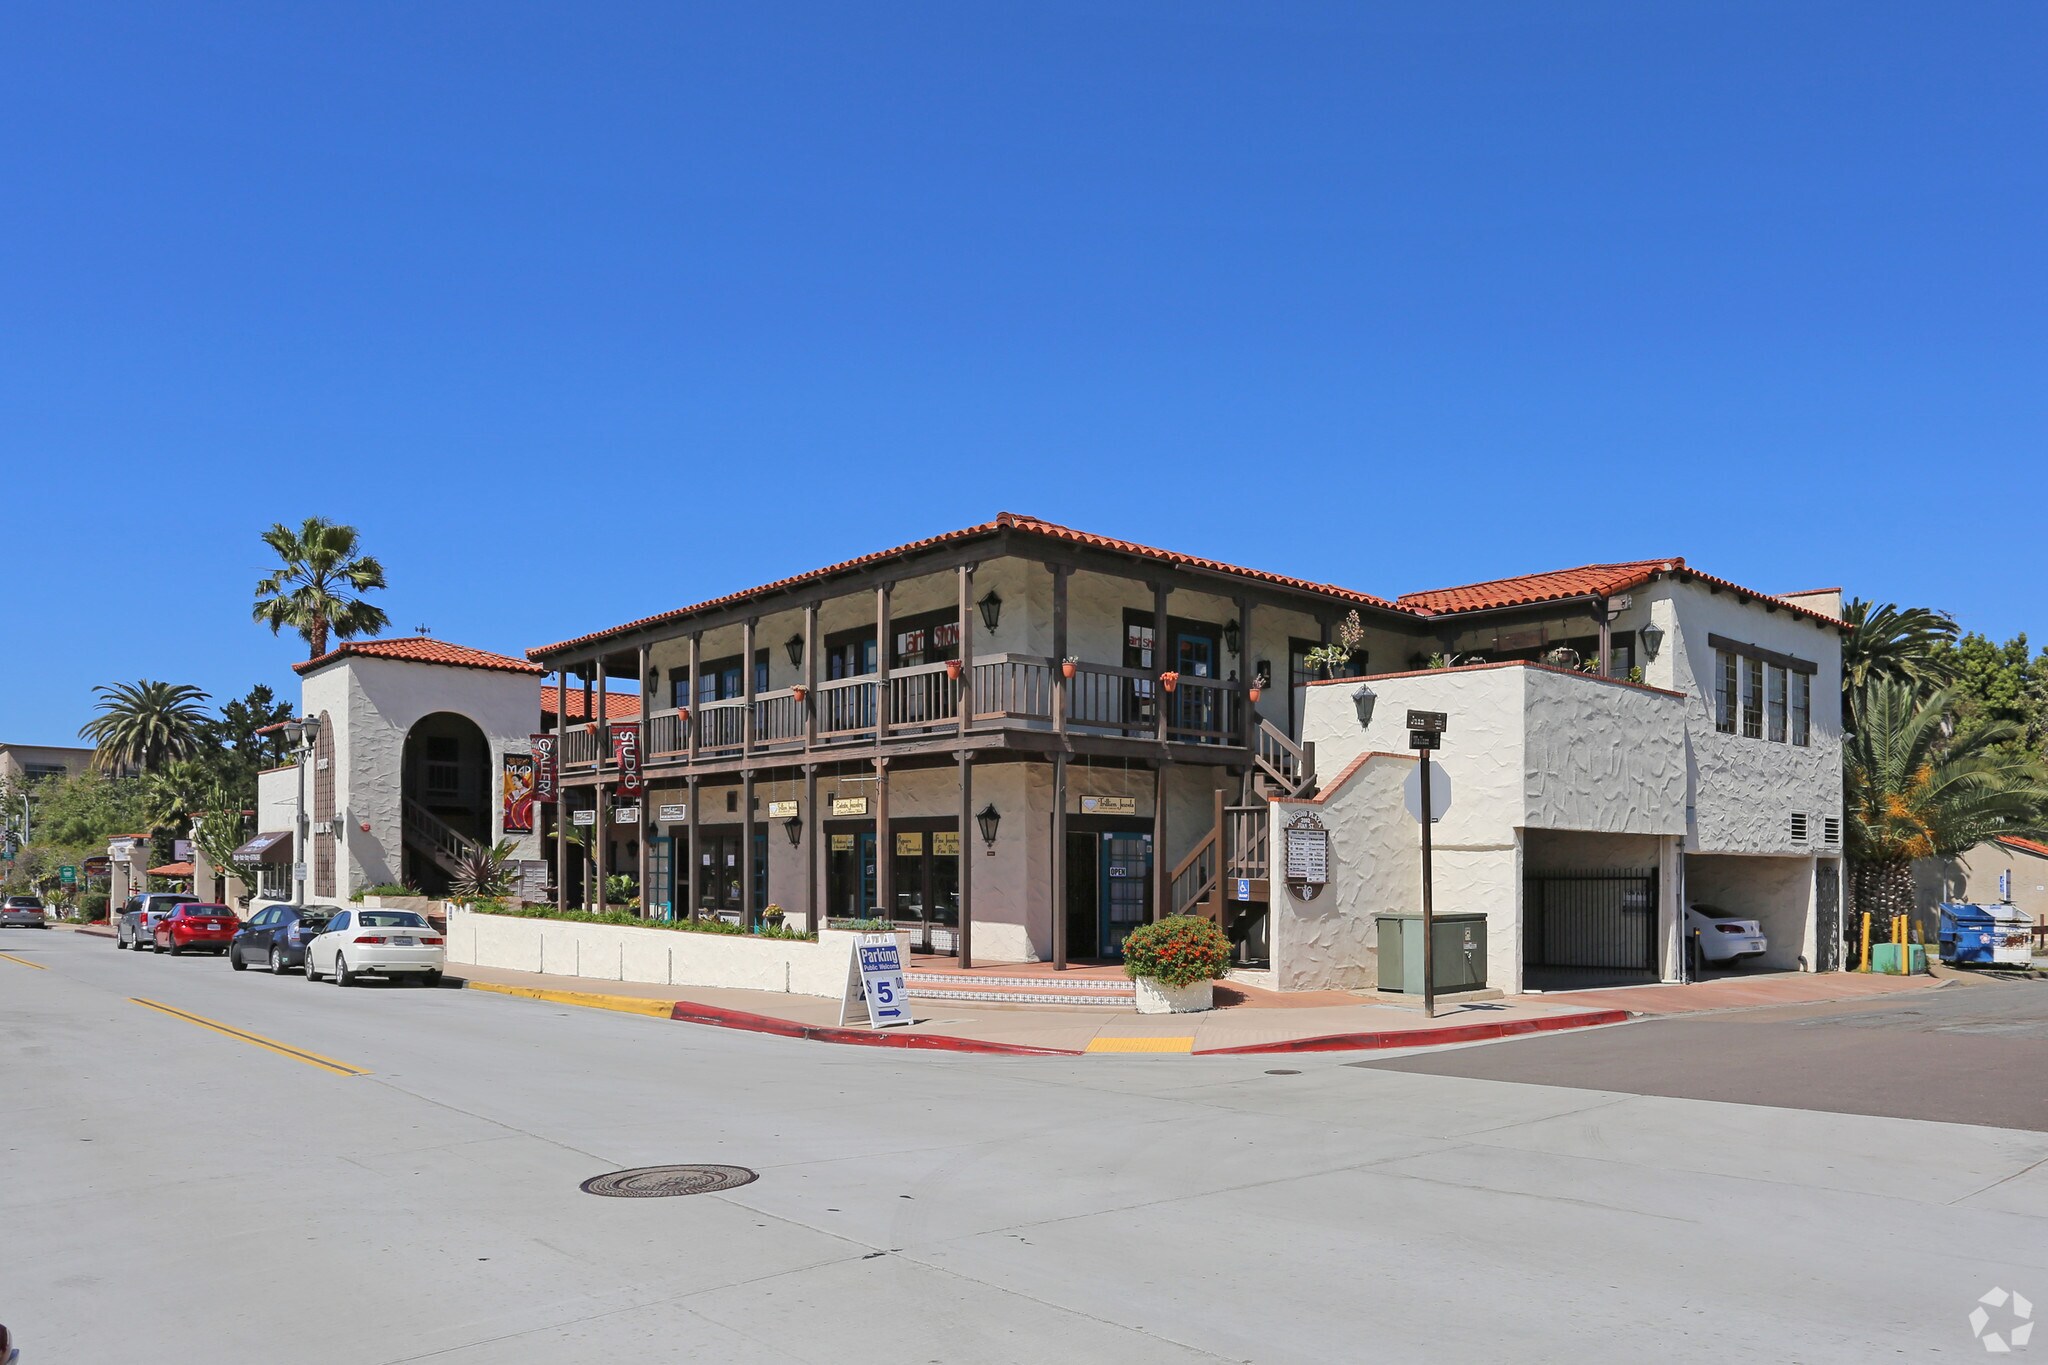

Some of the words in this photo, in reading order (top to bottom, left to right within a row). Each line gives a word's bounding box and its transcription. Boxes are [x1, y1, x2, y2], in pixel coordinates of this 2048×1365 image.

[538, 738, 552, 798] GALLERY
[619, 731, 640, 790] STUDIO
[1110, 868, 1126, 876] OPEN
[861, 947, 898, 964] Parking
[877, 981, 893, 1004] 5
